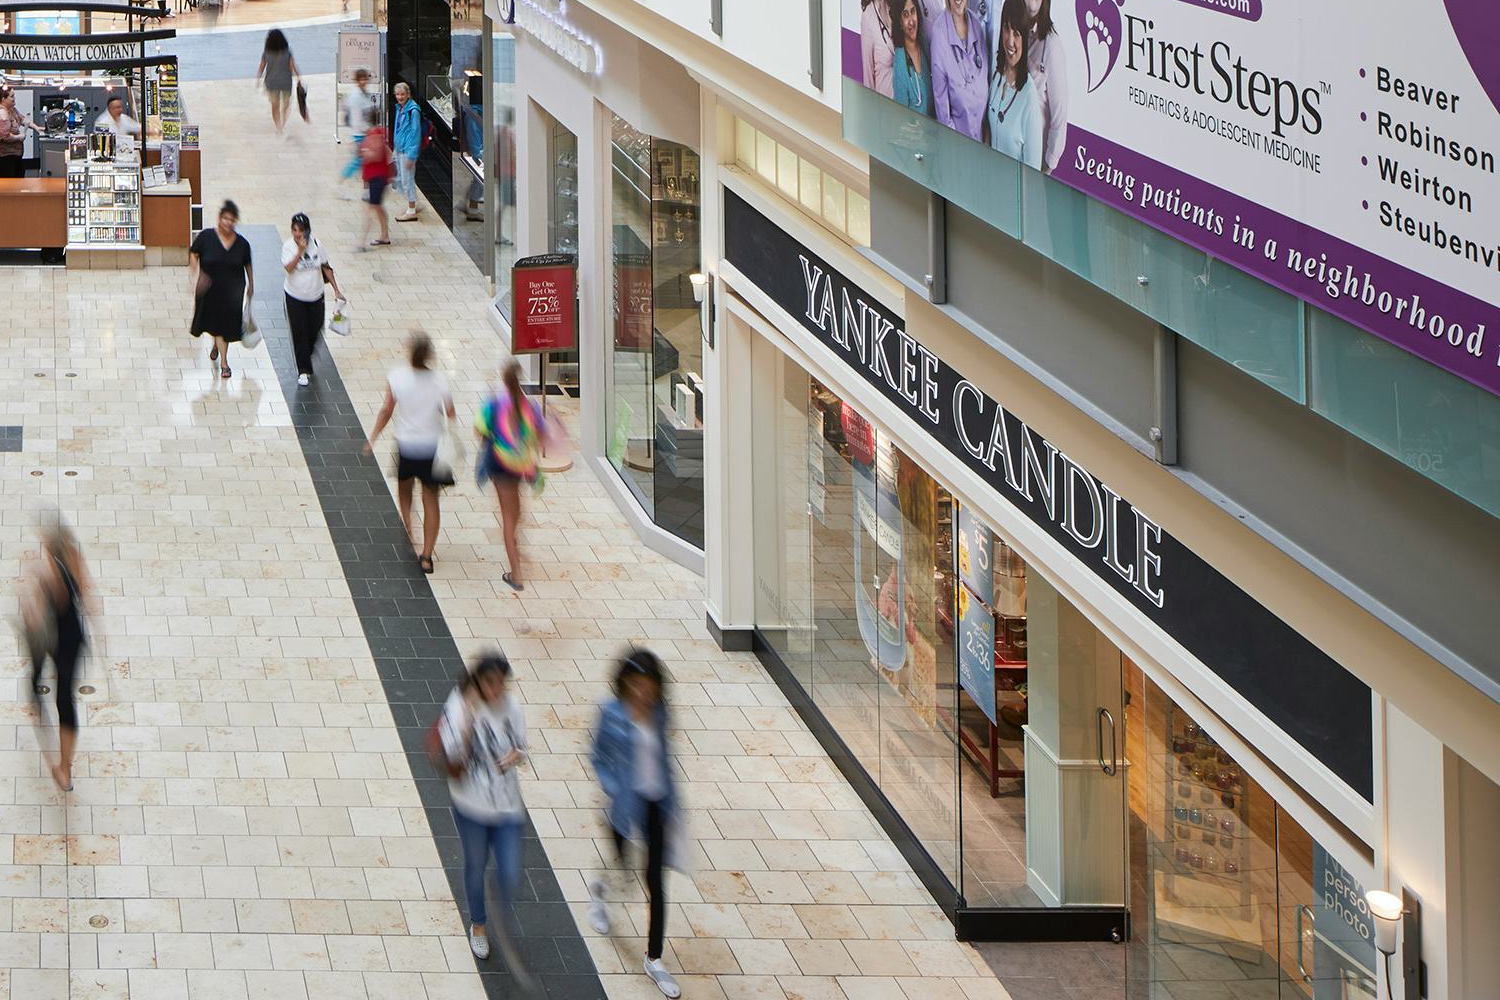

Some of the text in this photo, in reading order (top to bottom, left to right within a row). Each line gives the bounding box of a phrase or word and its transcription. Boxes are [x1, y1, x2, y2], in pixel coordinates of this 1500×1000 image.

[43, 45, 80, 61] WATCH
[86, 43, 136, 60] COMPANY
[1124, 13, 1206, 95] First
[1210, 41, 1323, 138] Steps
[1376, 66, 1460, 113] Beaver
[1129, 86, 1321, 174] PEDIATRICS & ADOLESCENT MEDICINE
[1378, 110, 1495, 173] Robinson
[1378, 155, 1472, 213] Weirton
[1074, 145, 1486, 358] Seeing patients in a neighborhood
[528, 296, 560, 315] 75%
[529, 281, 541, 289] Buy
[799, 255, 1164, 608] YANKEE CANDLE
[1325, 890, 1370, 939] photo
